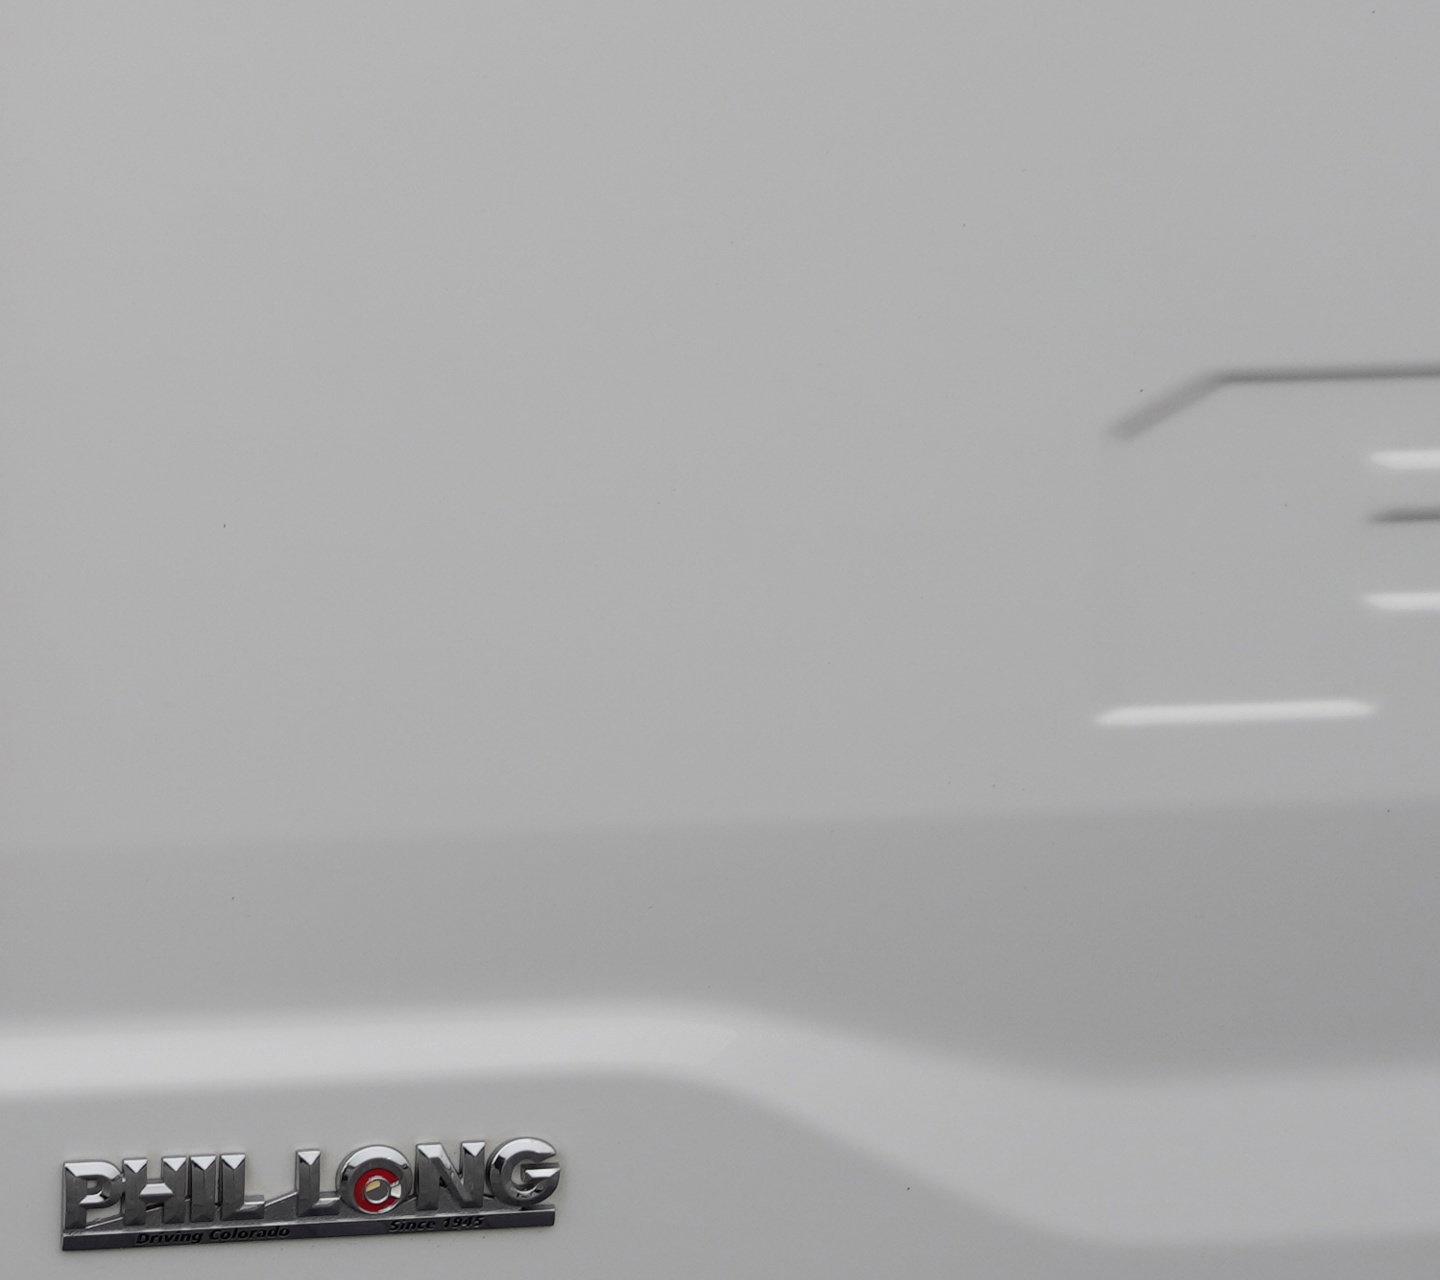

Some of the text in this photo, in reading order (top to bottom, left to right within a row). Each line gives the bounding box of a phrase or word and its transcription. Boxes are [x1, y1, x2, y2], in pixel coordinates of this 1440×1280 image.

[62, 1136, 561, 1230] PHIL LONG
[136, 1225, 290, 1247] Driving Colorado
[388, 1218, 436, 1233] Since
